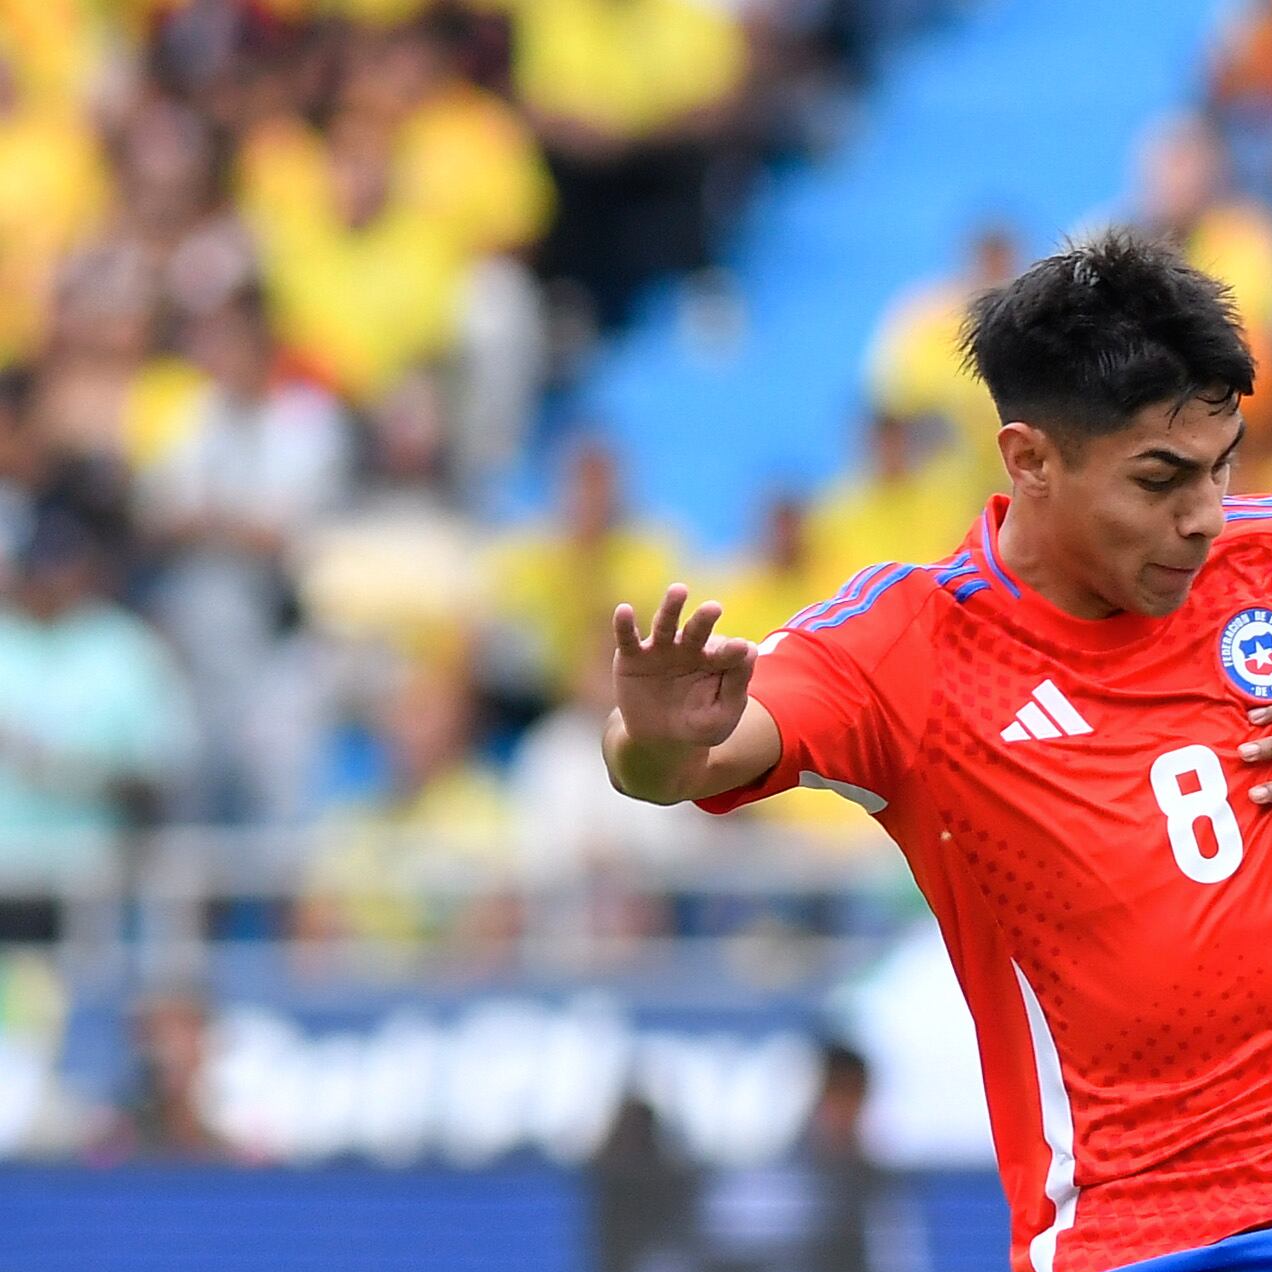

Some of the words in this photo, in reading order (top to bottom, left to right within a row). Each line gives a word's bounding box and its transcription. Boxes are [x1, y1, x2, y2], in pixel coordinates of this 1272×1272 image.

[1254, 610, 1267, 622] DE
[1254, 686, 1268, 697] DE
[1150, 744, 1244, 884] 8
